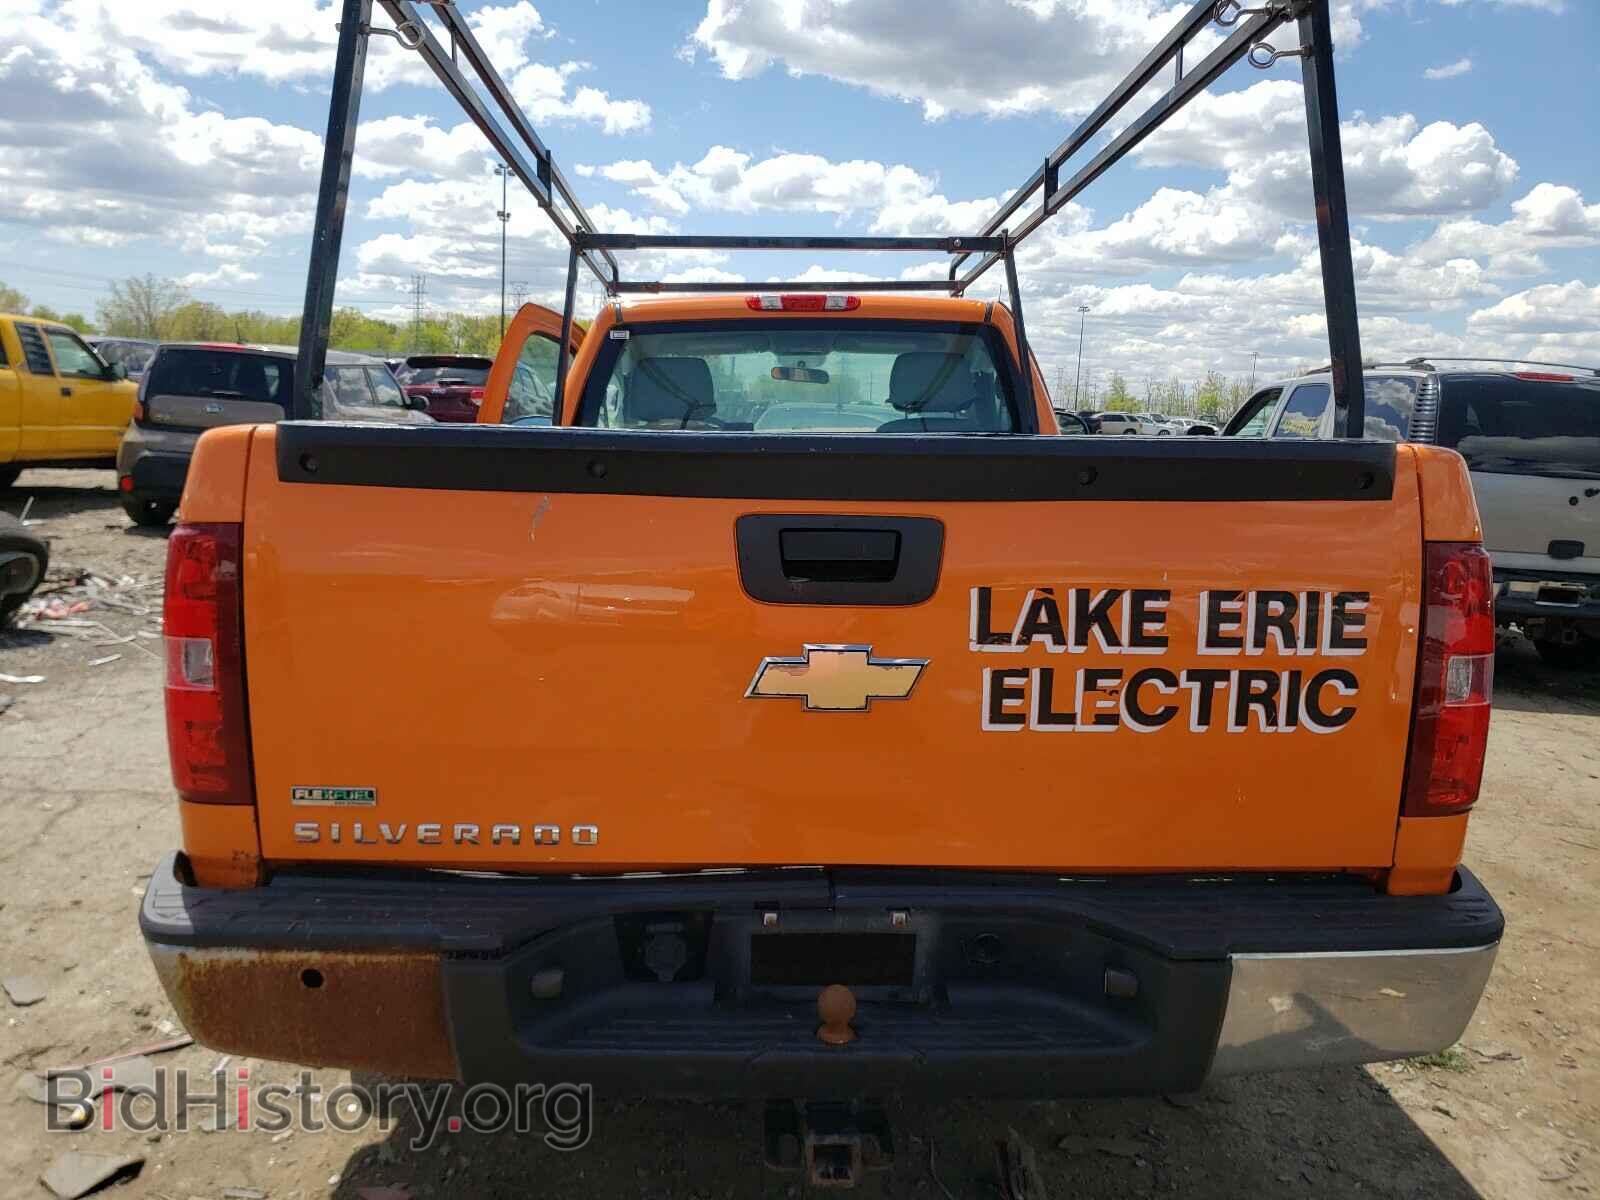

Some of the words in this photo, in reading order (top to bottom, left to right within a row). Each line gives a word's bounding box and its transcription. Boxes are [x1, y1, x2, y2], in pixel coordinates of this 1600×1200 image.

[969, 586, 1171, 654] LAKE
[1197, 590, 1370, 656] ERIE
[981, 667, 1359, 734] ELECTRIC
[293, 822, 599, 846] SILVERADO
